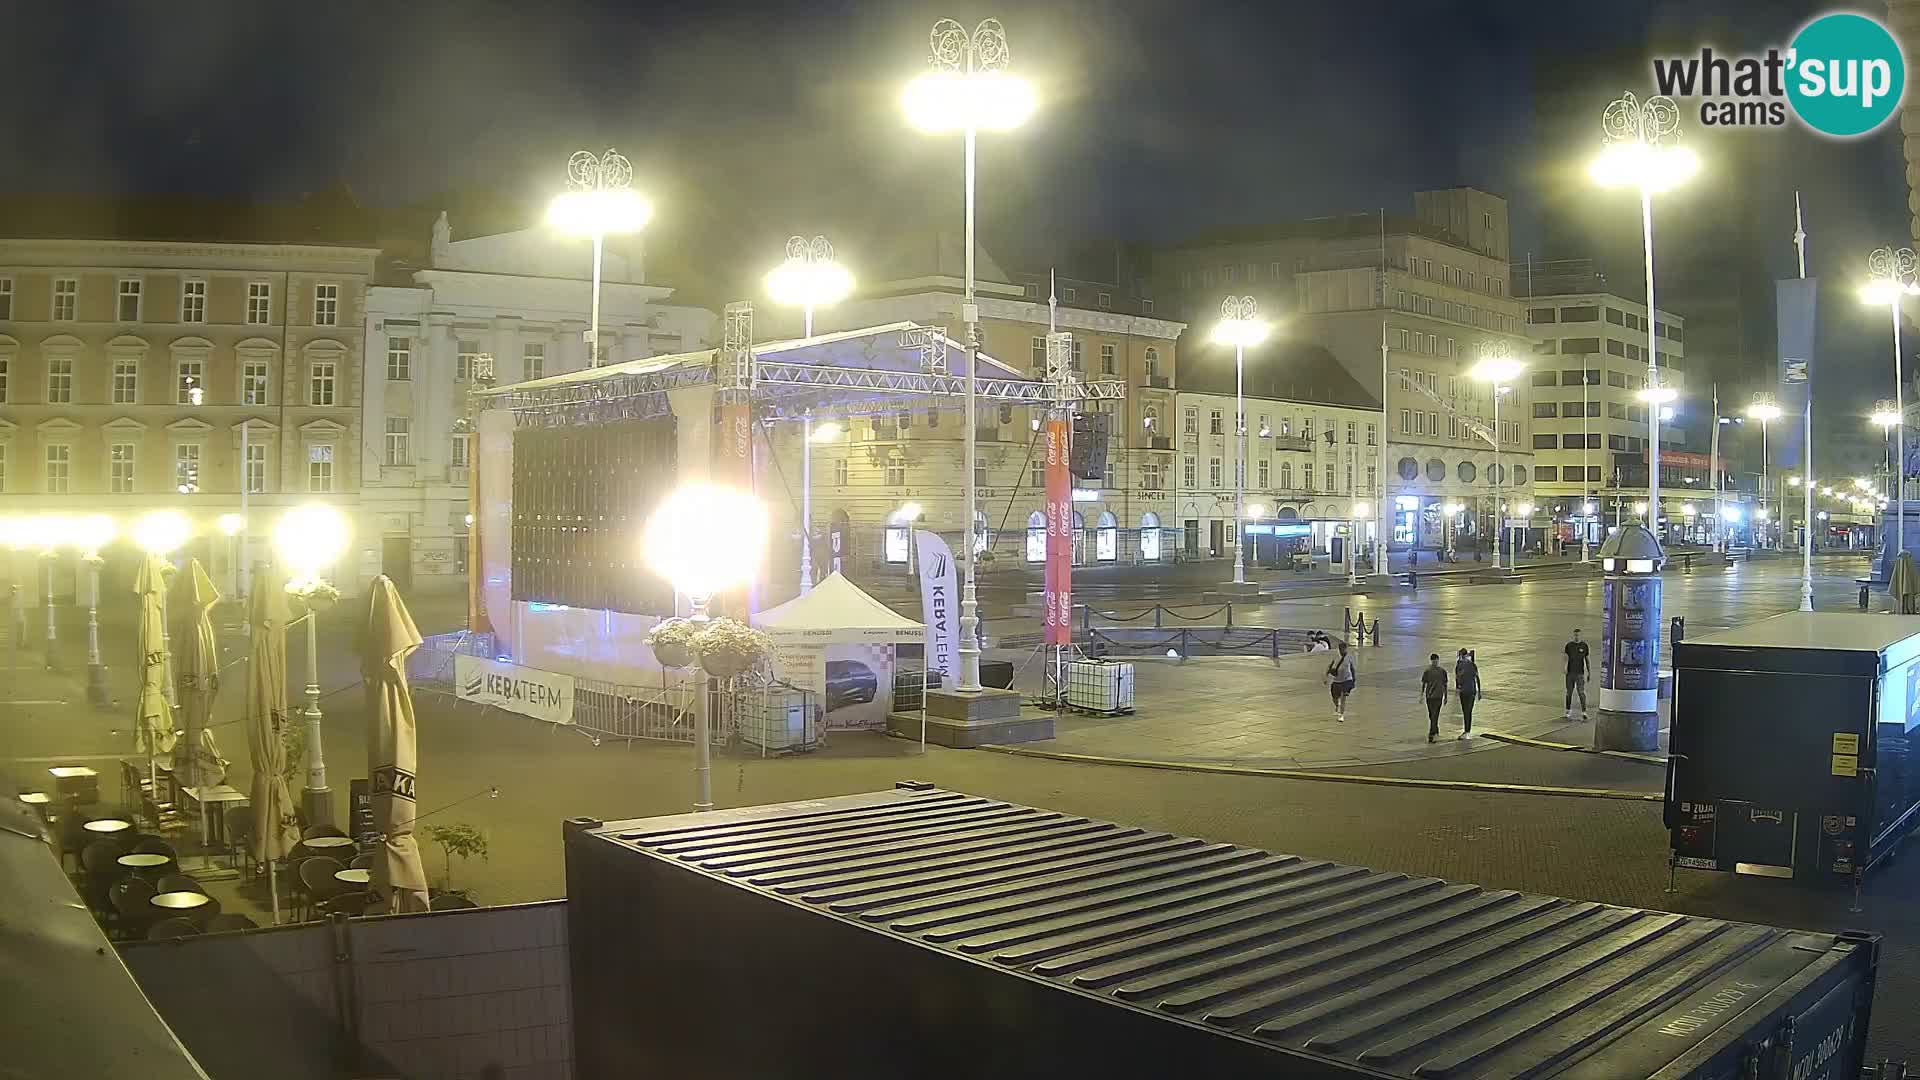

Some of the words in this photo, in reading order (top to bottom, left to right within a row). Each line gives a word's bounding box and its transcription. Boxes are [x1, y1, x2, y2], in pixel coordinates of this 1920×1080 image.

[960, 488, 996, 497] SGER
[1137, 487, 1165, 500] SINGER
[487, 673, 561, 709] KERATERM
